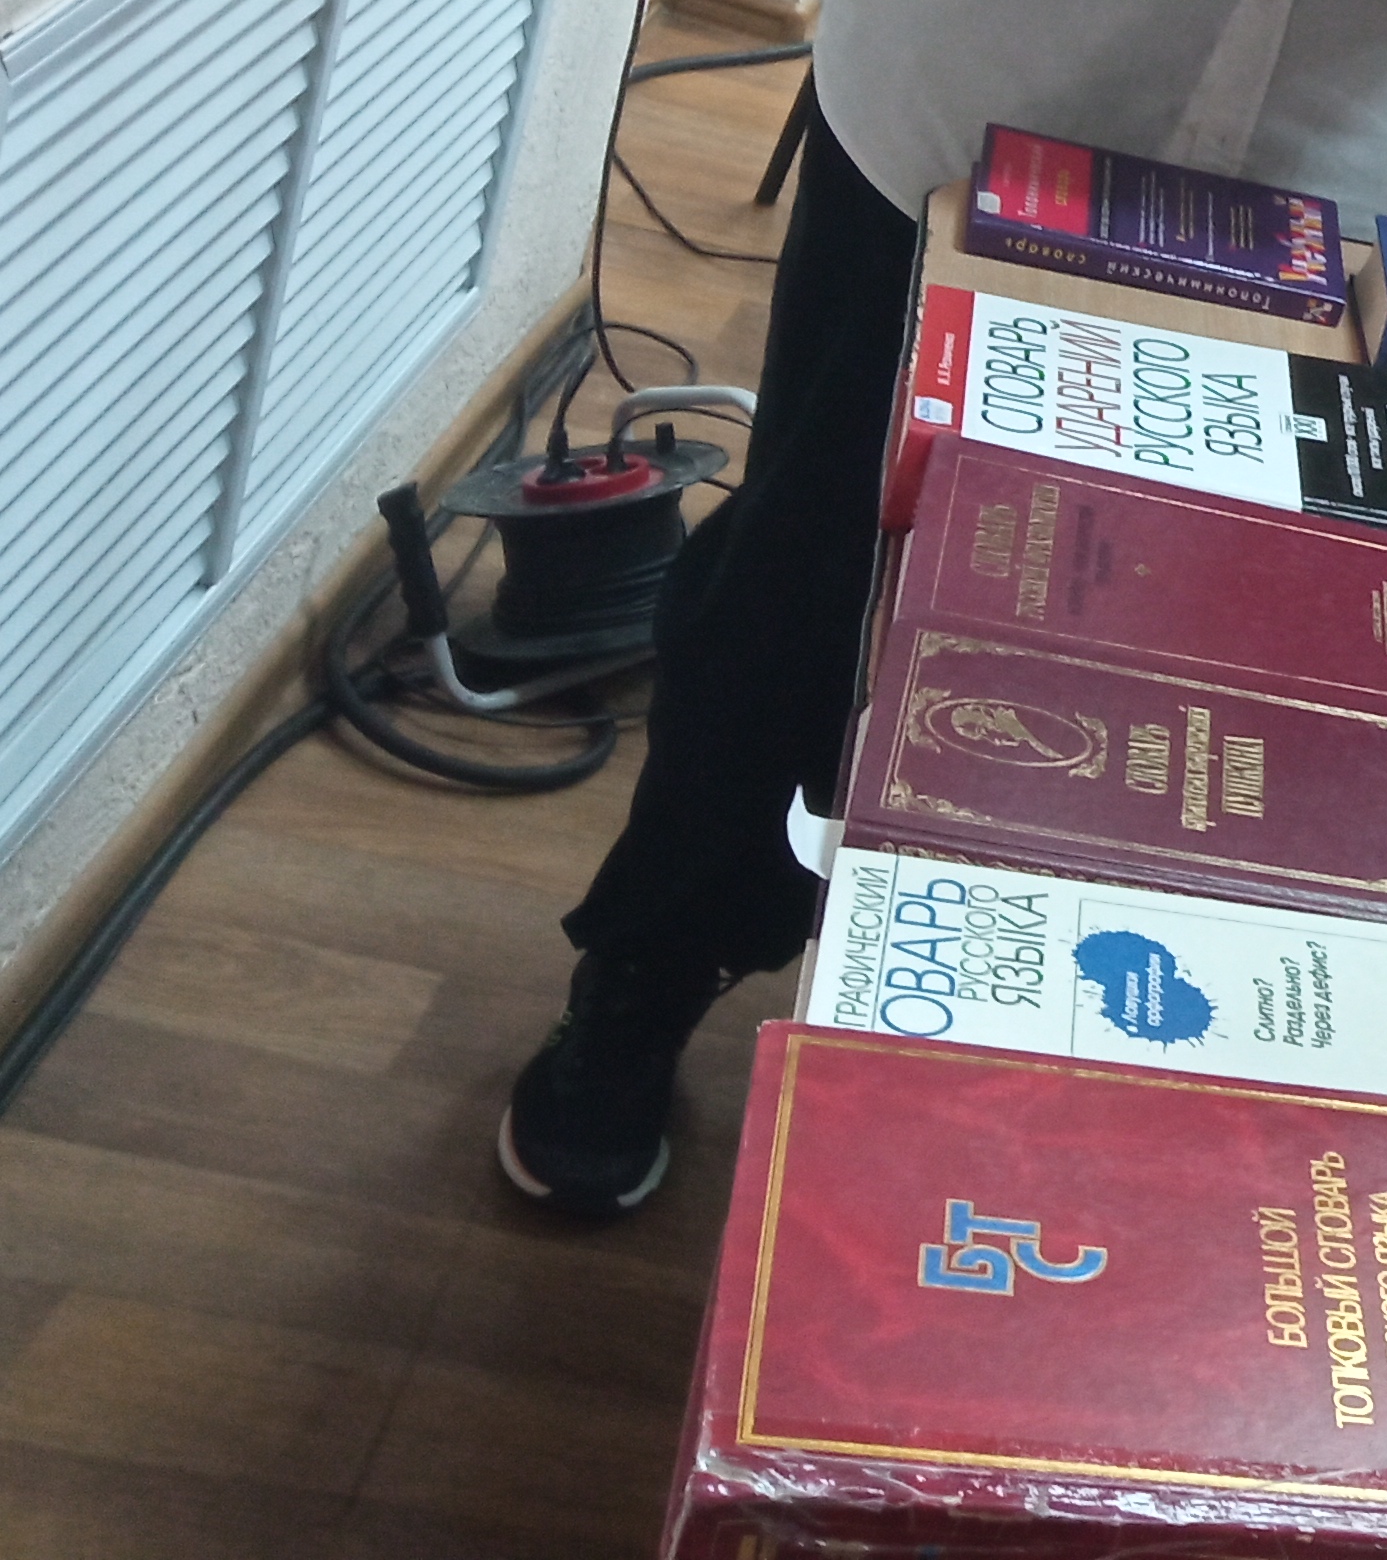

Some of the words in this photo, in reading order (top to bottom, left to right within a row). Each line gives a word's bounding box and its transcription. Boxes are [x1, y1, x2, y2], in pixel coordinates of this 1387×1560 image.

[981, 317, 1050, 435] СЛОВАРЬ
[1050, 318, 1126, 458] УДАРЕНИЙ
[1133, 338, 1195, 472] РУССКОГО
[1203, 373, 1264, 463] ЯЗЫКА
[1125, 722, 1170, 794] СЛОВАРЬ
[1221, 735, 1264, 818] ПУШКИНА
[957, 885, 999, 1002] РУССКОГО
[991, 891, 1049, 1009] ЯЗЫКА
[1278, 956, 1308, 1047] Раздельно?
[1305, 939, 1333, 1002] дефис?
[1252, 976, 1277, 1043] Слитно?
[1308, 1002, 1336, 1050] Через
[1309, 1151, 1357, 1270] СЛОВАРЬ
[1251, 1206, 1307, 1349] БОЛЬШОЙ
[1314, 1274, 1374, 1429] ТОЛКОВЫЙ
